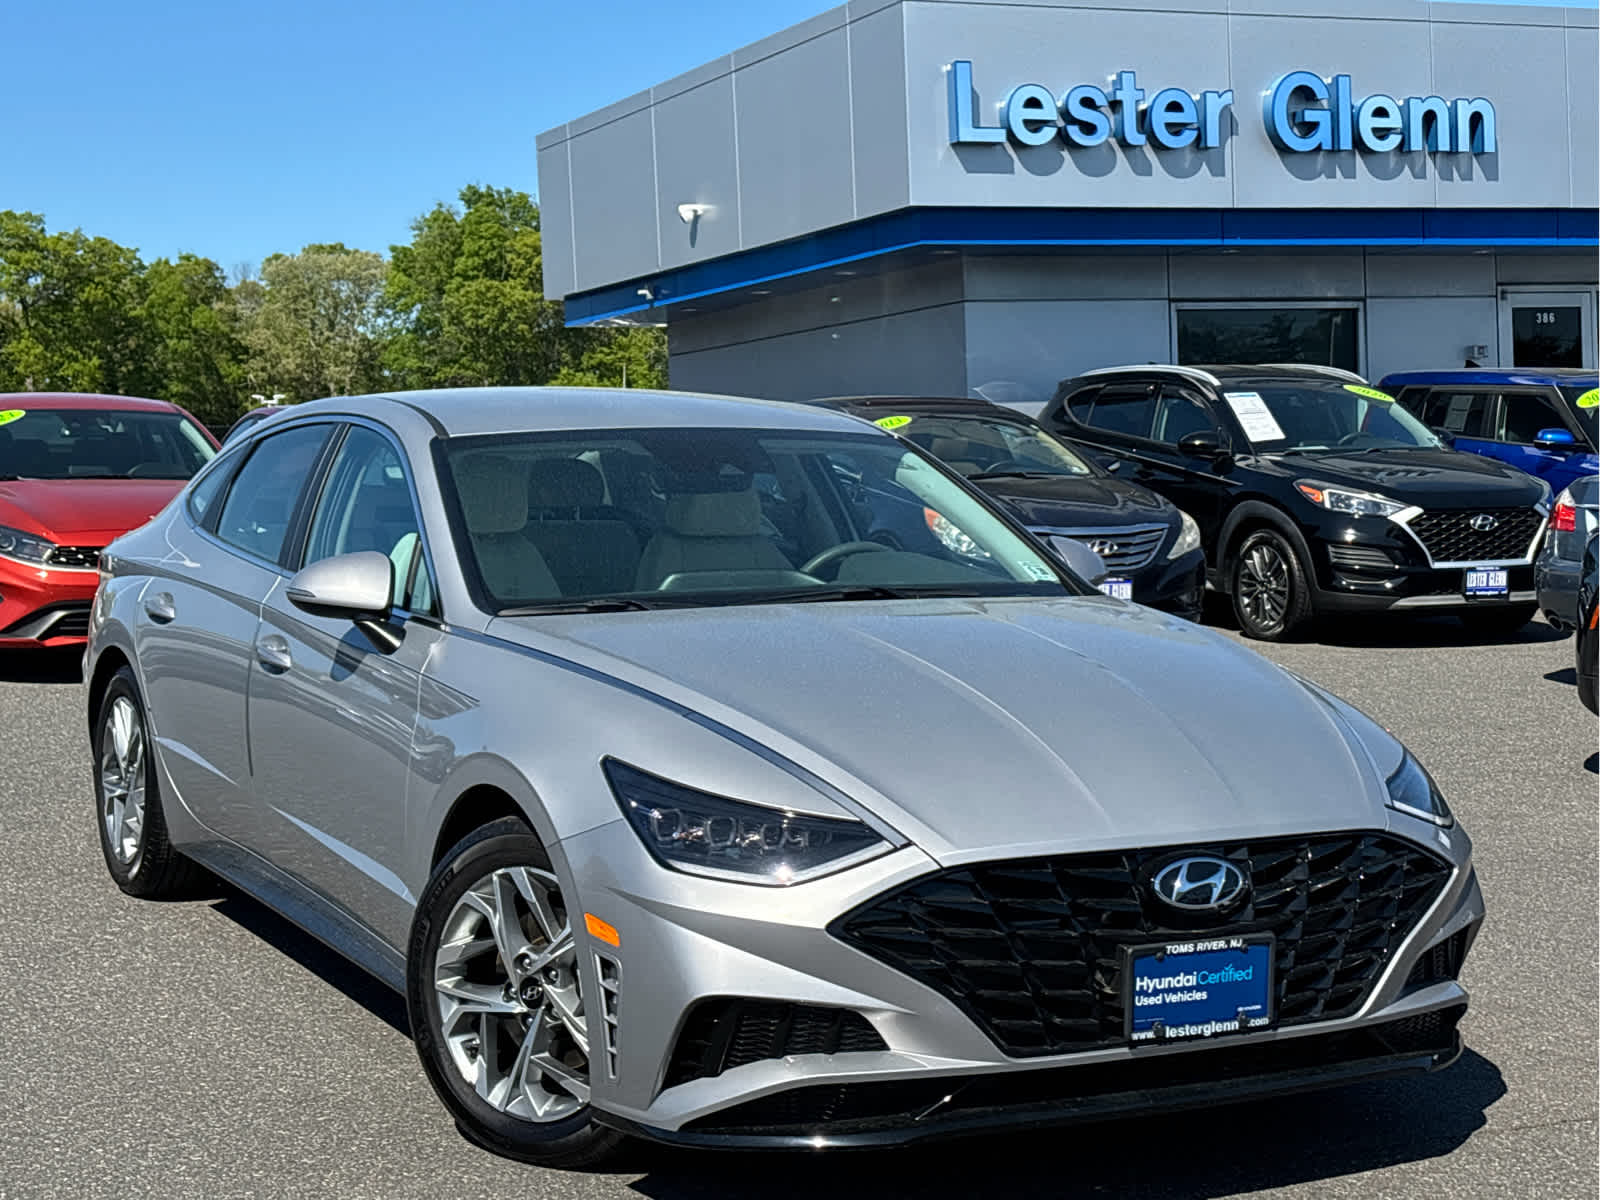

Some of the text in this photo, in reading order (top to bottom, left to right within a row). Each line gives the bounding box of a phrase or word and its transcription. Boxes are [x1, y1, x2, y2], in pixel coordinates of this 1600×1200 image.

[948, 61, 1497, 154] Lester Glenn
[1535, 312, 1556, 324] 386
[1165, 944, 1194, 955] TOMS
[1230, 938, 1243, 948] NJ
[1135, 963, 1253, 993] Hyundai Certified
[1135, 990, 1208, 1006] Used Vehicles
